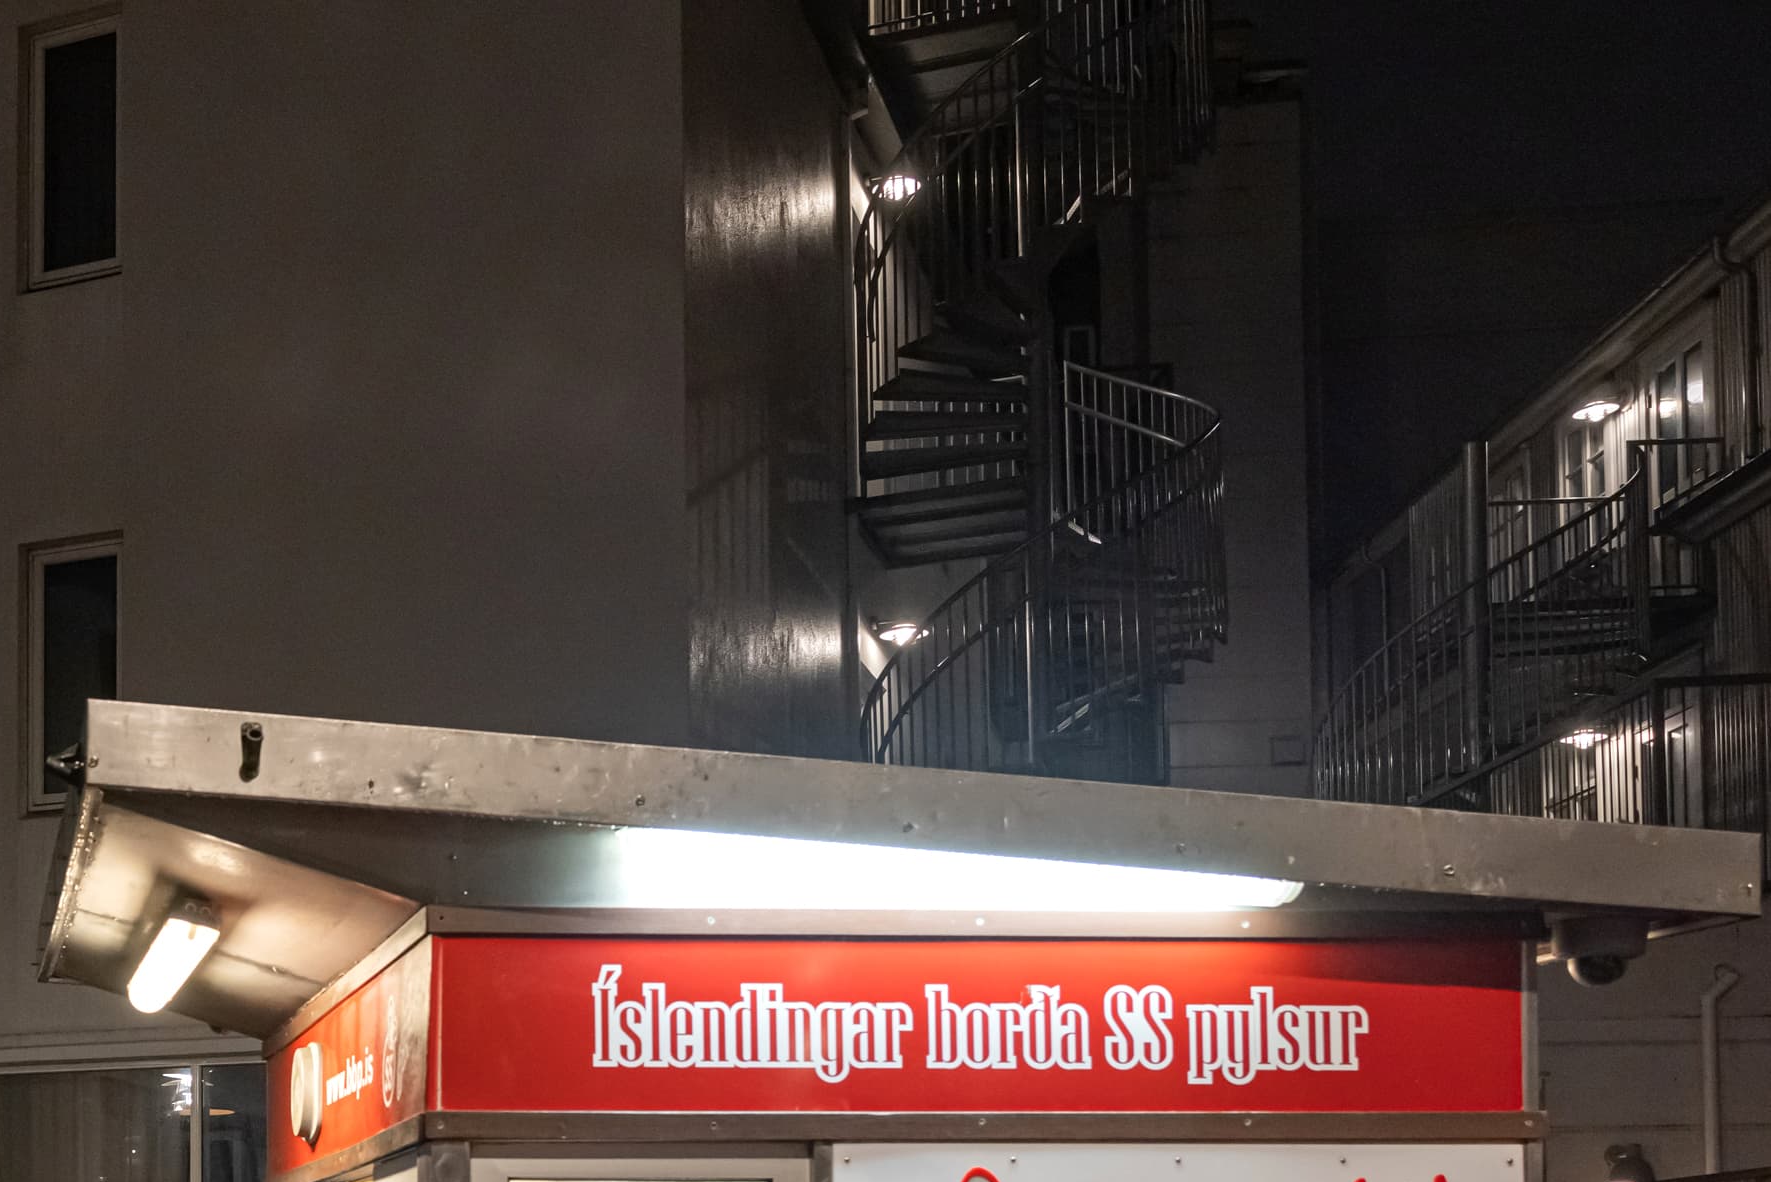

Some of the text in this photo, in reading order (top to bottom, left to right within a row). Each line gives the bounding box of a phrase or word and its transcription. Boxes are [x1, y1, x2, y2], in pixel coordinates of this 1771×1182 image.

[592, 964, 1370, 1085] Íslendingar borða SS pylsur
